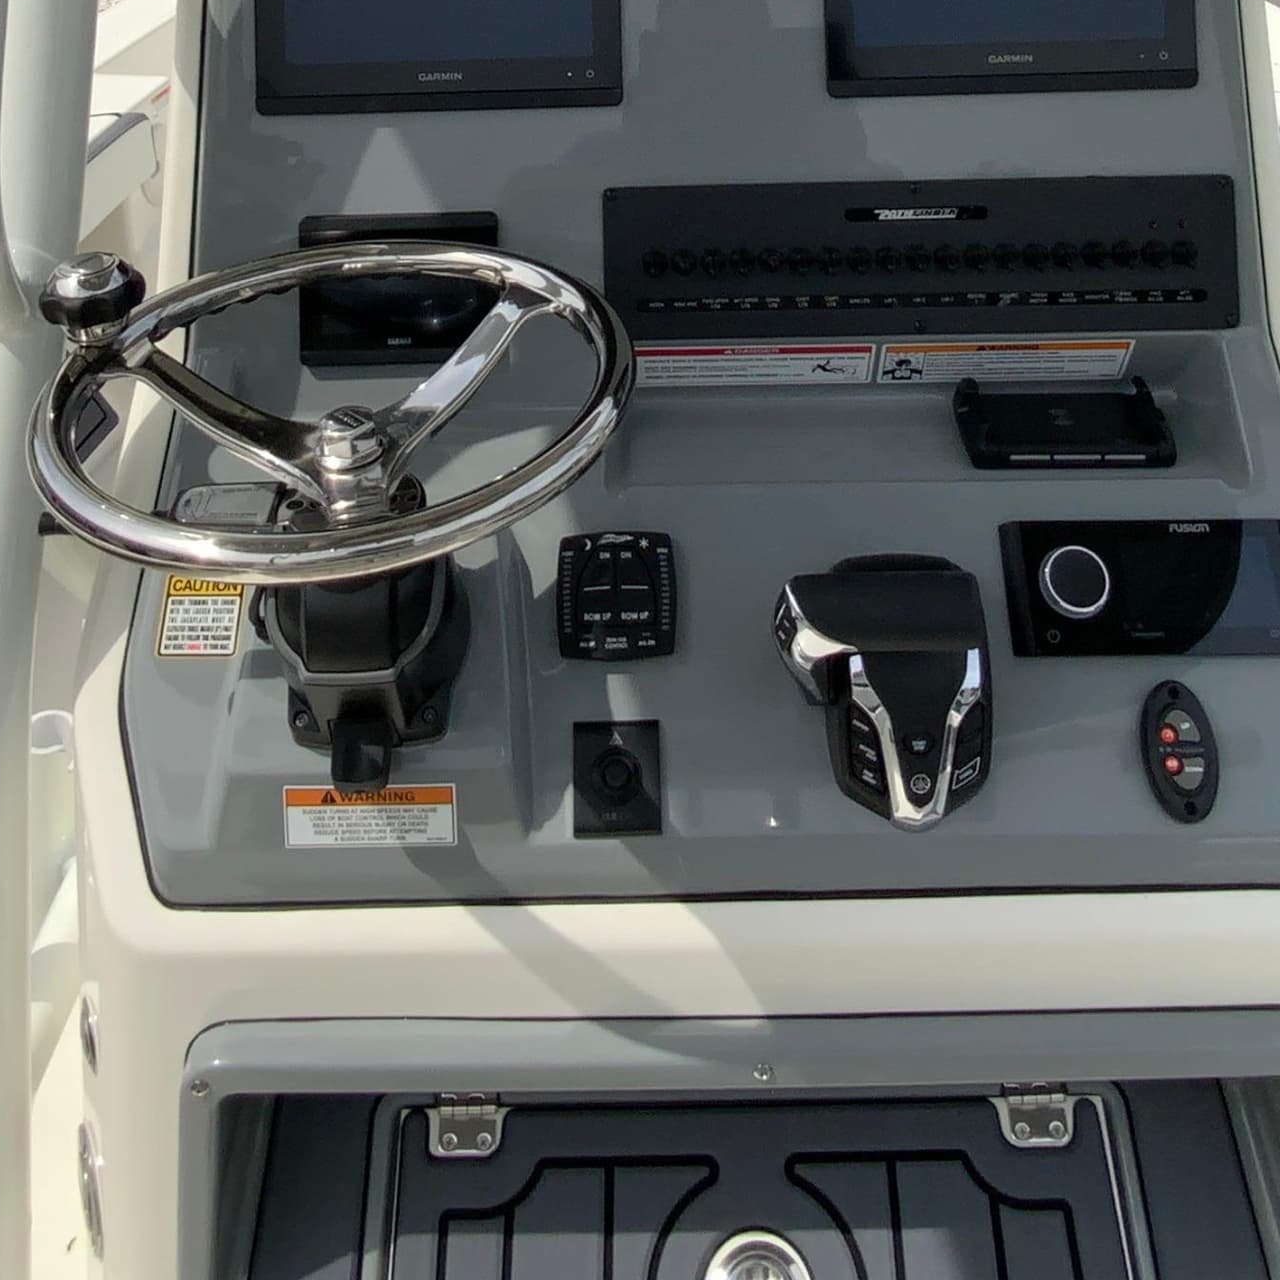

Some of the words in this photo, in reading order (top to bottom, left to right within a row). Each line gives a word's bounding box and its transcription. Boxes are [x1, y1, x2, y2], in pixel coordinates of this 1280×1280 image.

[418, 72, 463, 81] GARMIN
[1169, 523, 1210, 533] FUSION
[172, 579, 238, 592] CAUTION
[339, 790, 416, 802] WARNING
[987, 1055, 1033, 1064] GARMIN
